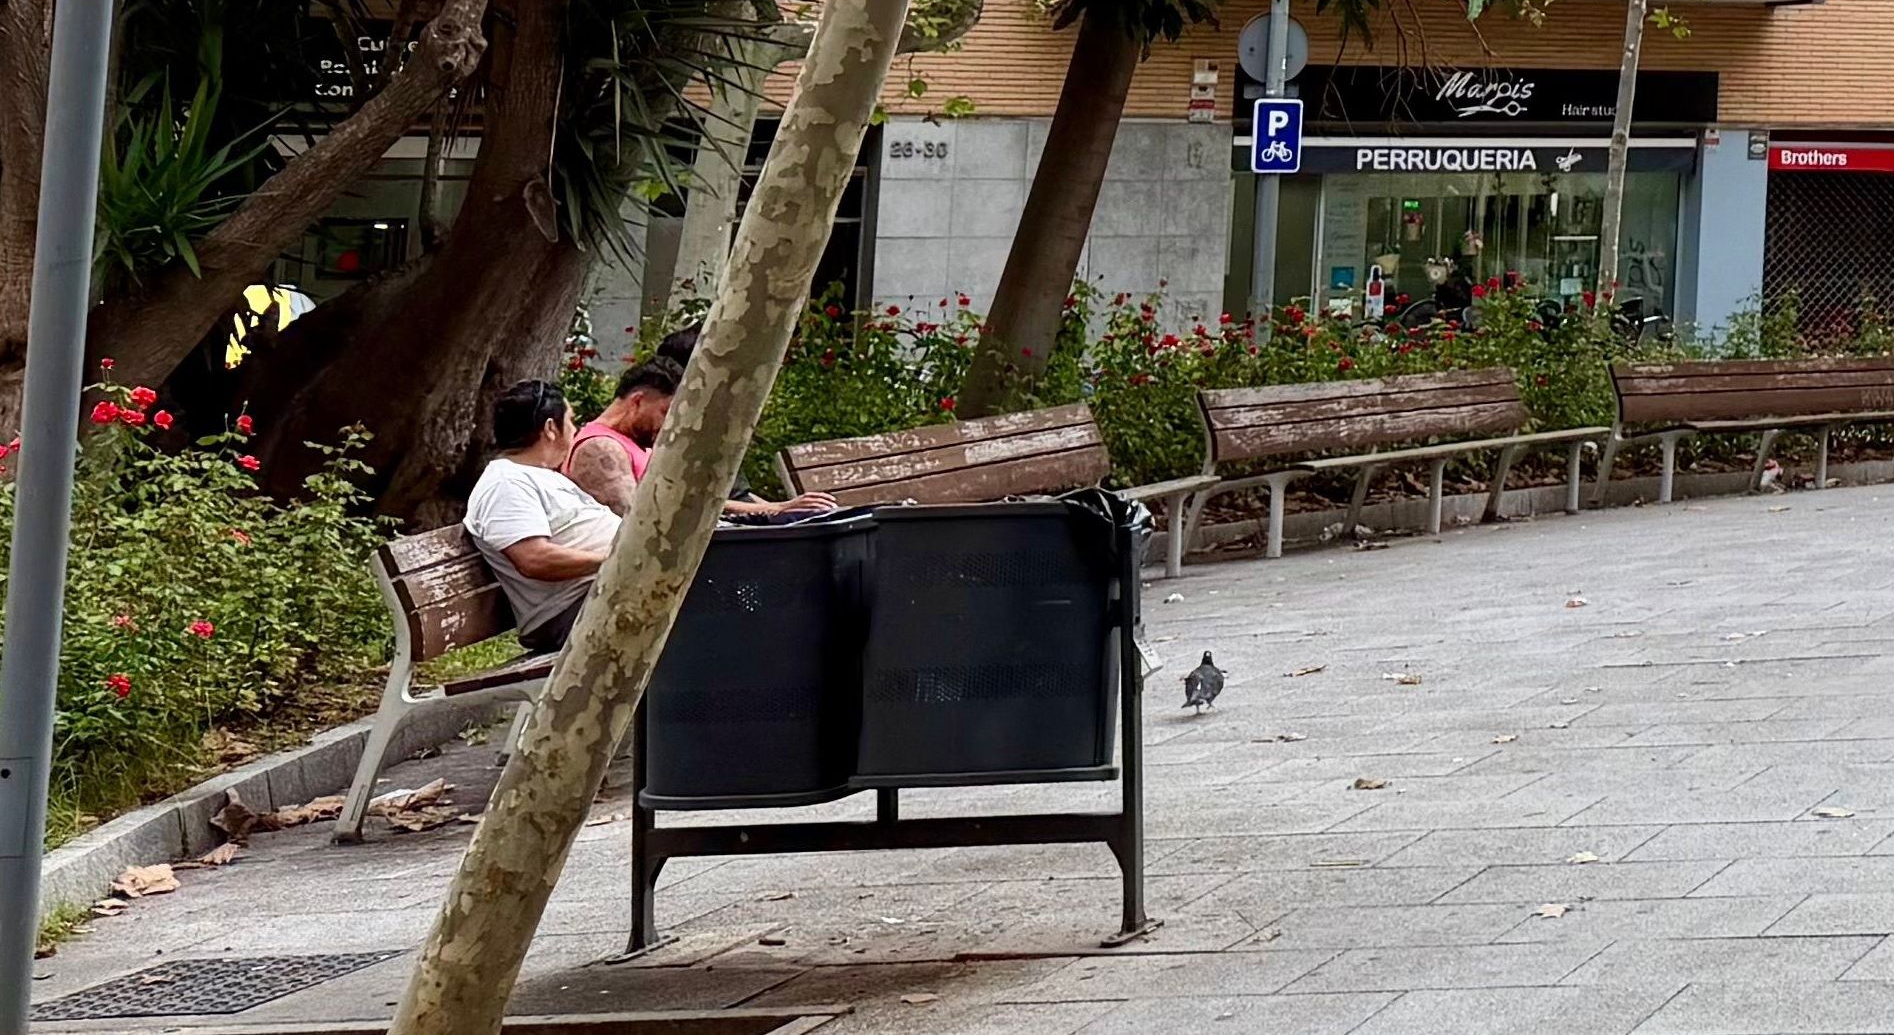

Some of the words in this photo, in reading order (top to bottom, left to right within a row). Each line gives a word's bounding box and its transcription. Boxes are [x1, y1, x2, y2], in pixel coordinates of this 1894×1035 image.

[1268, 110, 1289, 137] P
[1356, 149, 1537, 171] PERRUQUERIA
[1780, 149, 1848, 166] Brothers
